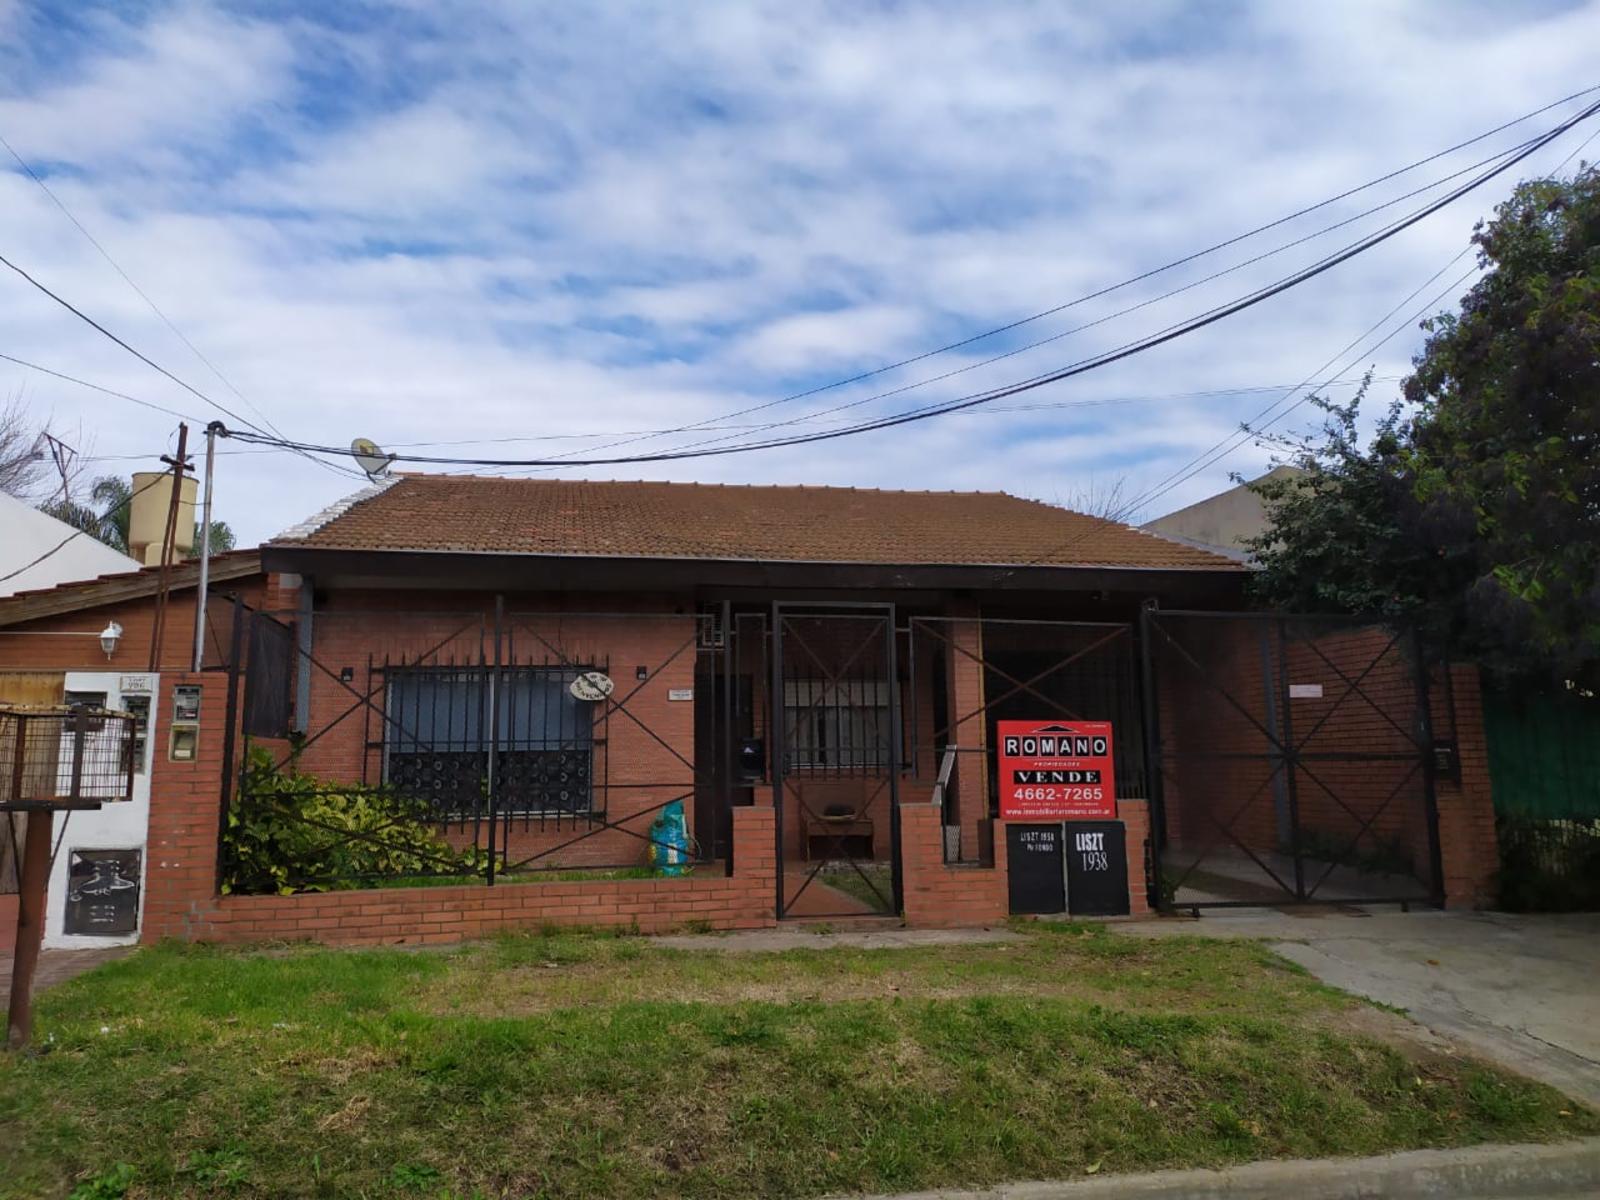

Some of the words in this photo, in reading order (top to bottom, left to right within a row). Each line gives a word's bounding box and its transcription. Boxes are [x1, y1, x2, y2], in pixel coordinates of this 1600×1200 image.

[1006, 738, 1106, 754] ROMANO
[1018, 771, 1097, 782] VENDE
[1014, 788, 1103, 800] 4662-7265
[1076, 833, 1104, 851] LISZT
[1083, 852, 1108, 871] 1938
